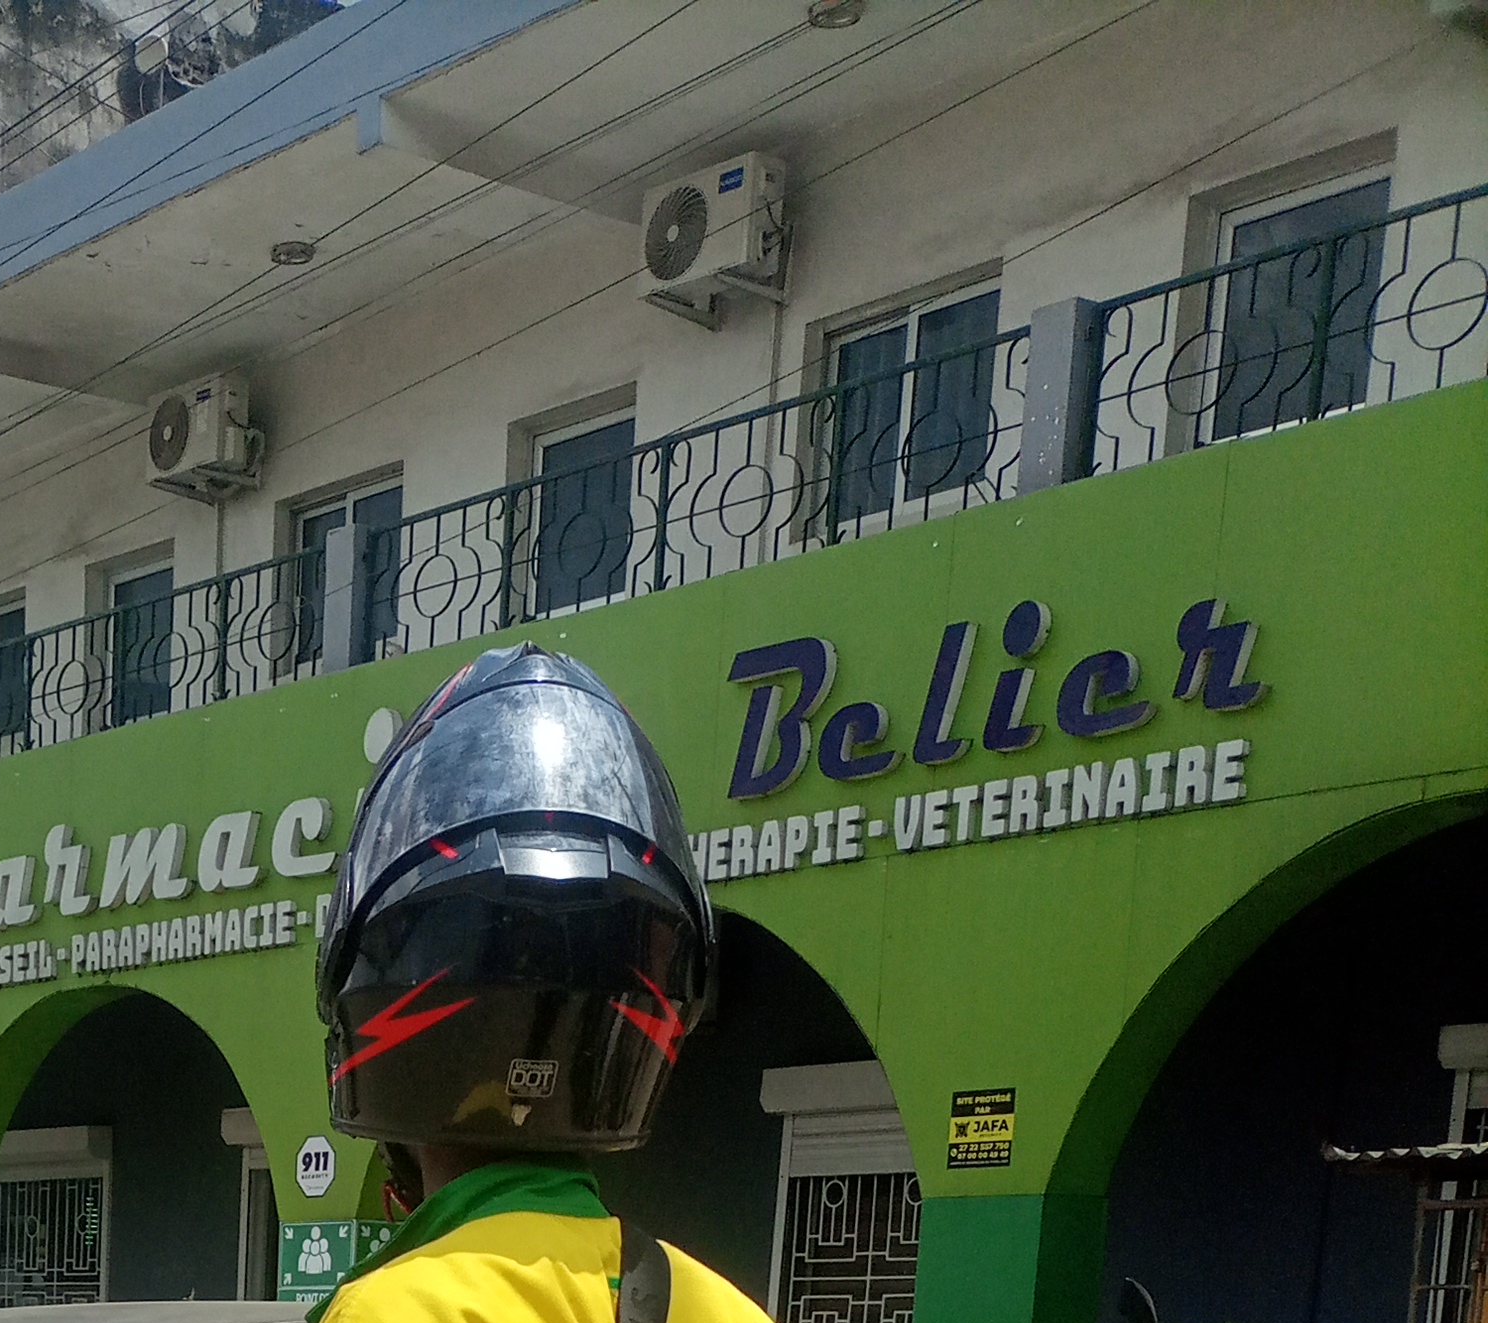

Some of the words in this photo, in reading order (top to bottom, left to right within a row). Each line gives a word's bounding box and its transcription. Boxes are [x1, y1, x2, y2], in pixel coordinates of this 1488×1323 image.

[726, 599, 1272, 801] Belier
[511, 1069, 554, 1087] DOT
[974, 1106, 991, 1114] PAR
[973, 1119, 1009, 1133] JAFA
[301, 1151, 329, 1173] 911
